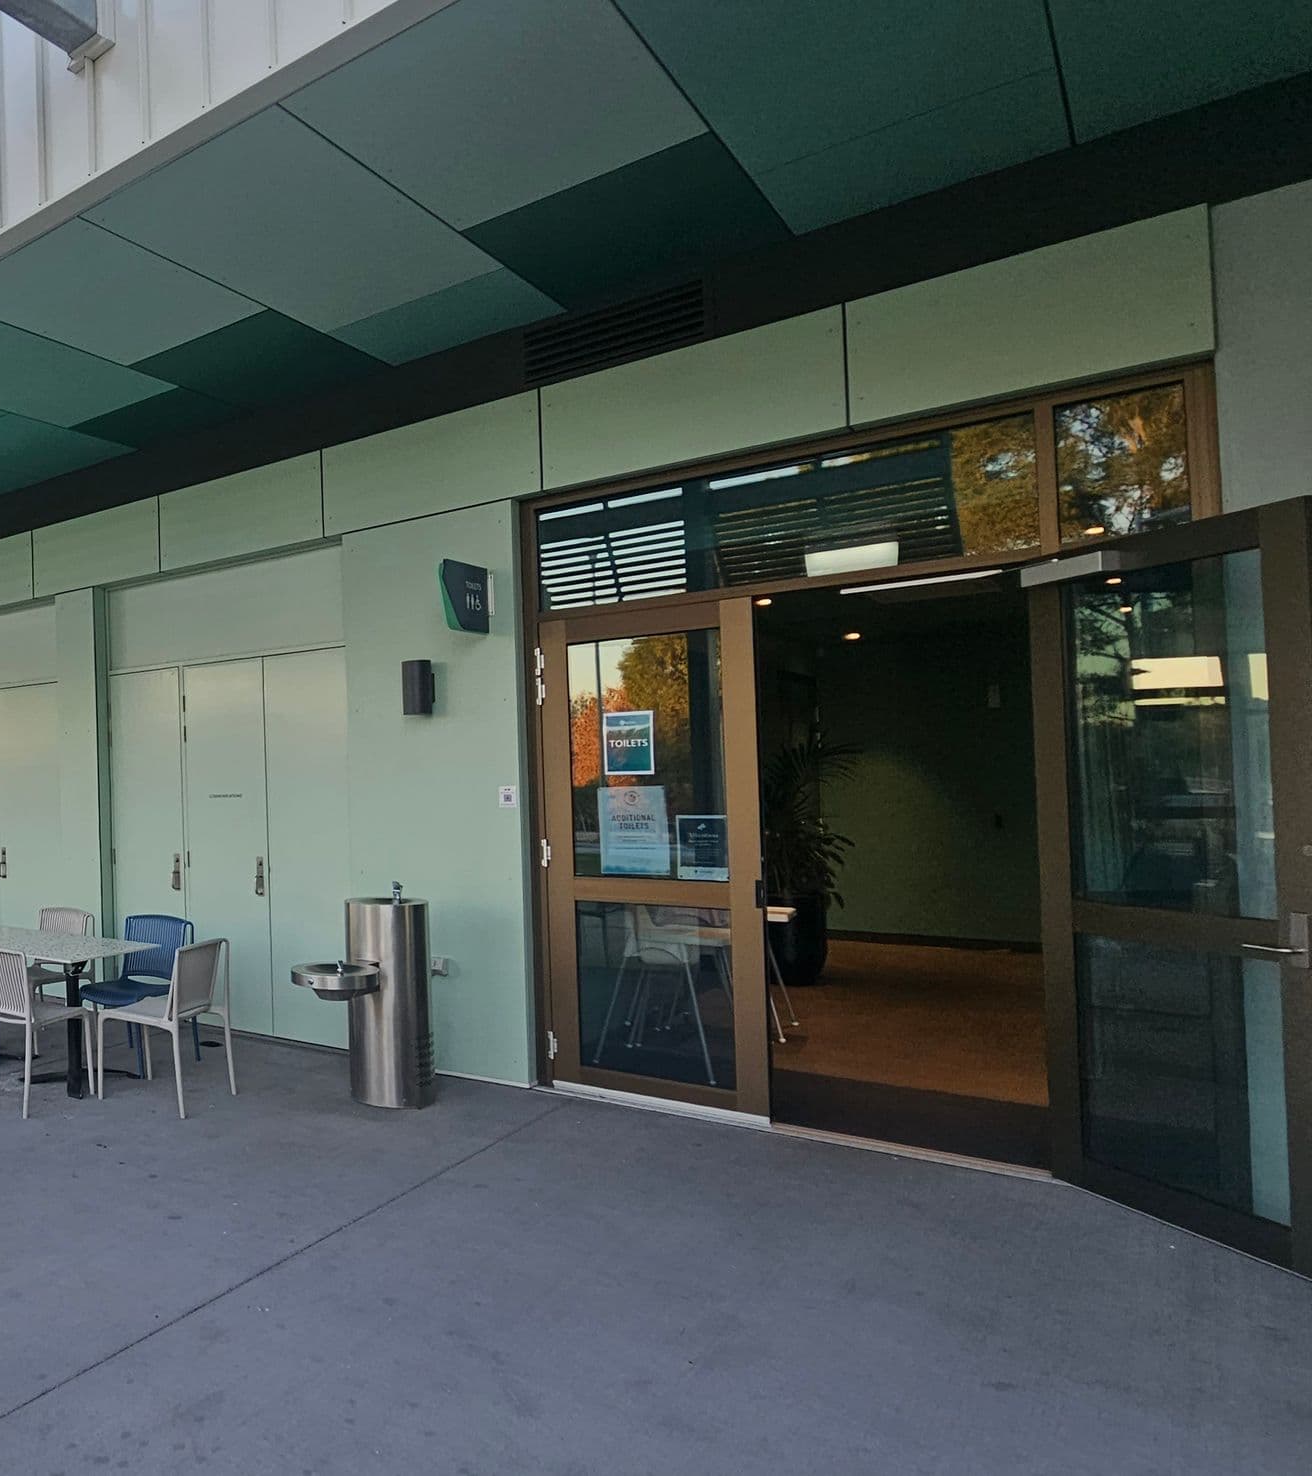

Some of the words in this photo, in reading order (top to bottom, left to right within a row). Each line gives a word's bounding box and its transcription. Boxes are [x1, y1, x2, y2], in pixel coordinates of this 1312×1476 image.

[609, 739, 648, 748] TOILETS
[611, 814, 655, 822] ADDITIONAL
[619, 822, 649, 830] TOILETS
